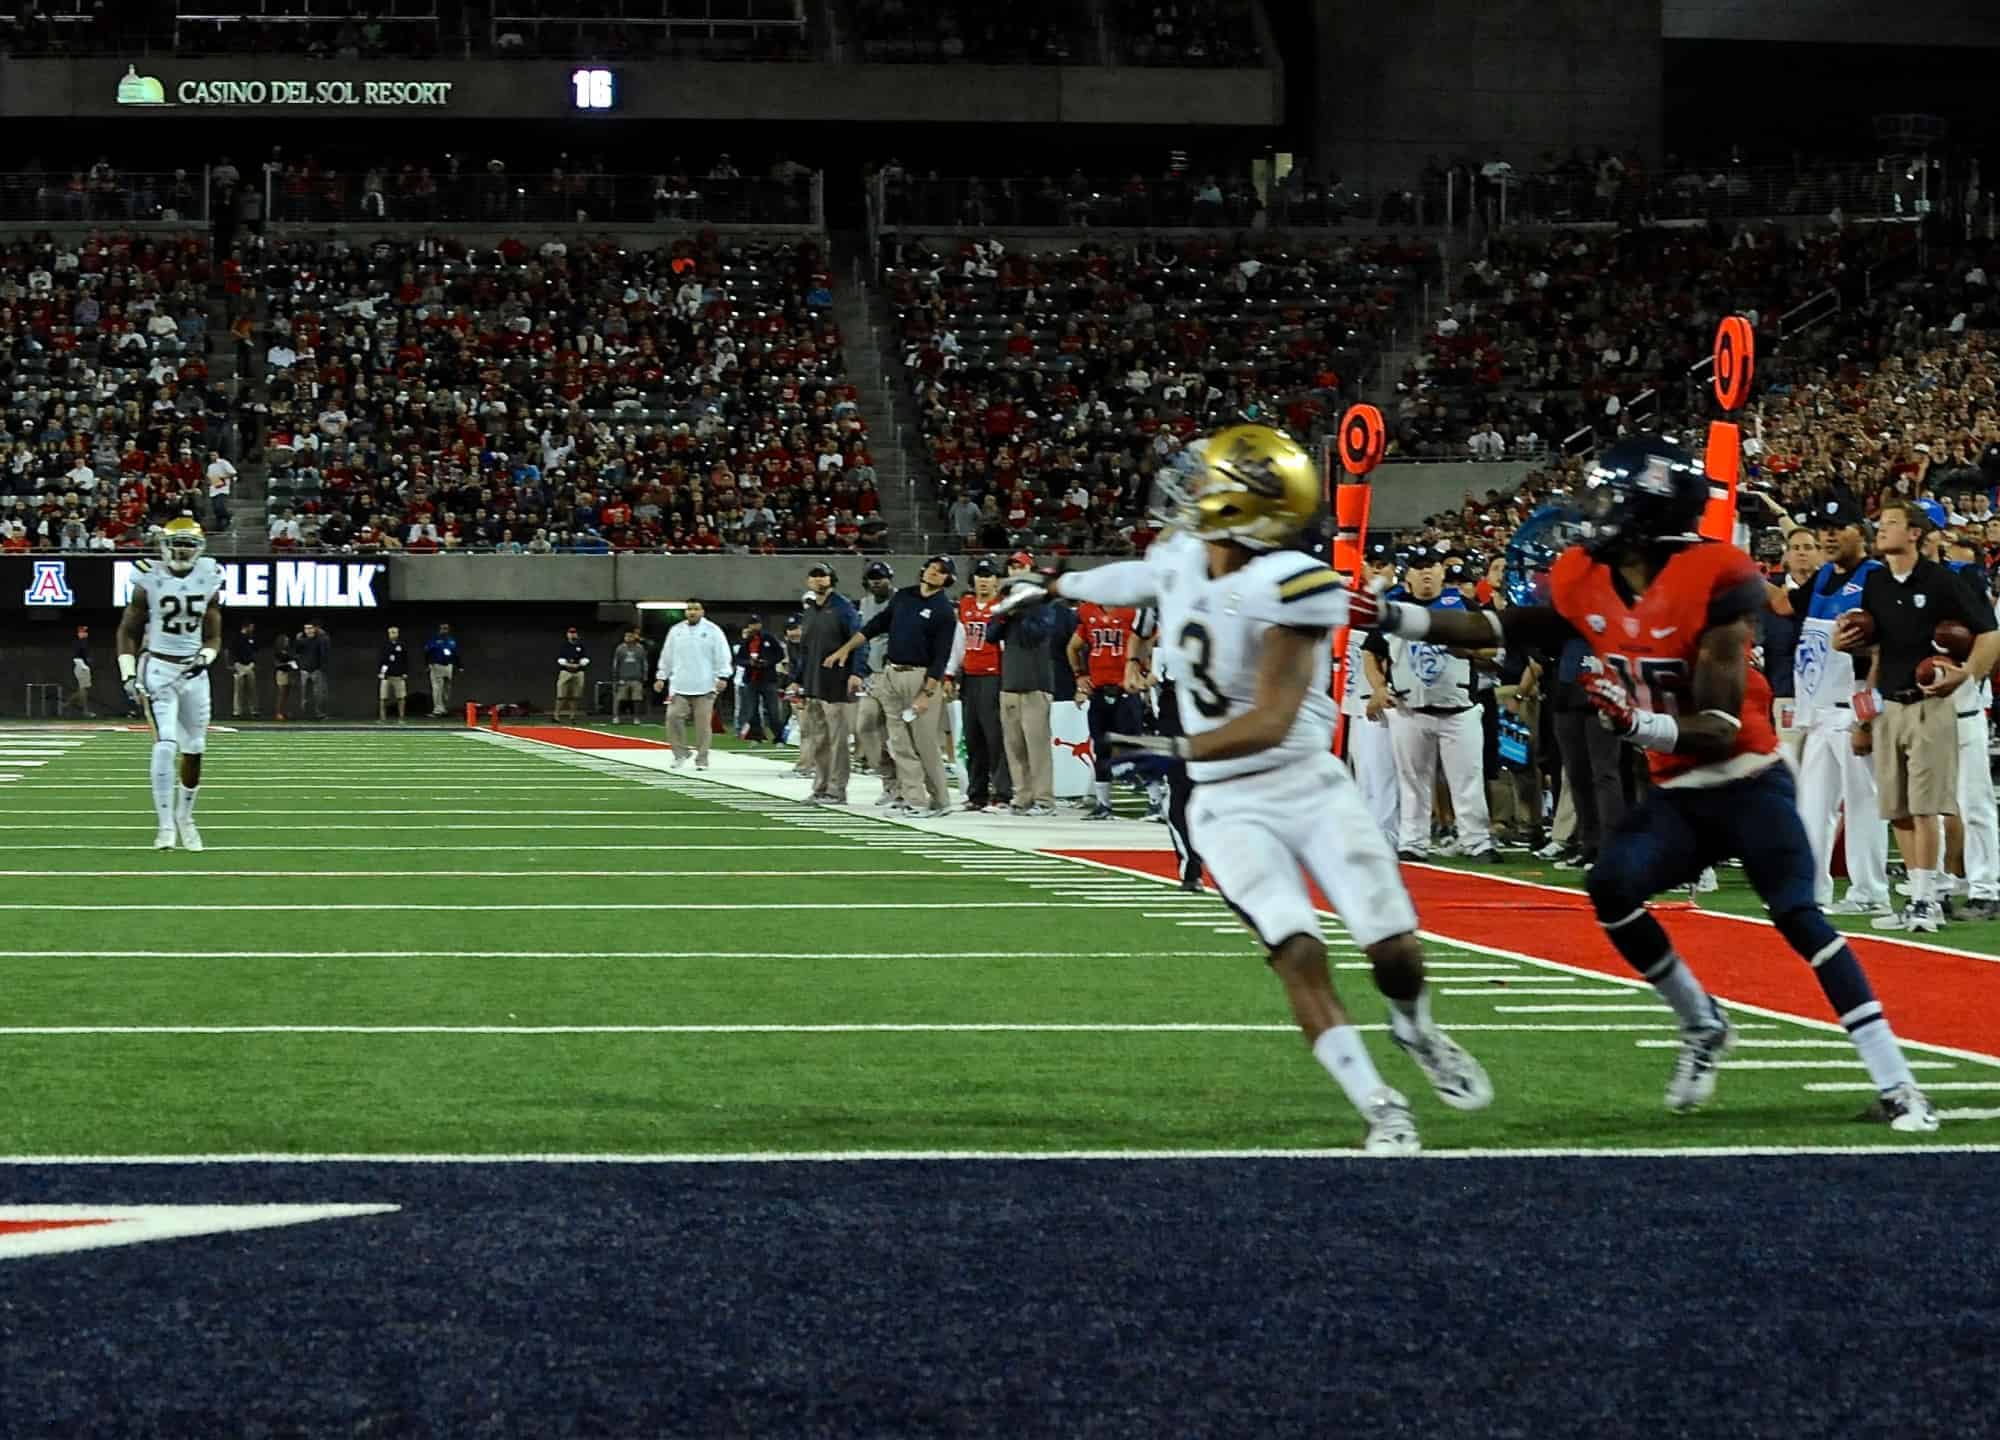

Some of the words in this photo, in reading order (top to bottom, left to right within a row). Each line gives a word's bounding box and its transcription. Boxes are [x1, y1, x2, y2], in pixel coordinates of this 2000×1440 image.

[178, 81, 267, 104] CASINO
[270, 81, 314, 104] DEL
[316, 81, 361, 104] SOL
[364, 81, 452, 104] RESORT
[572, 71, 613, 108] 16
[275, 561, 378, 607] MILK
[160, 595, 204, 635] 25
[1090, 628, 1124, 657] 14
[1178, 620, 1232, 719] 3
